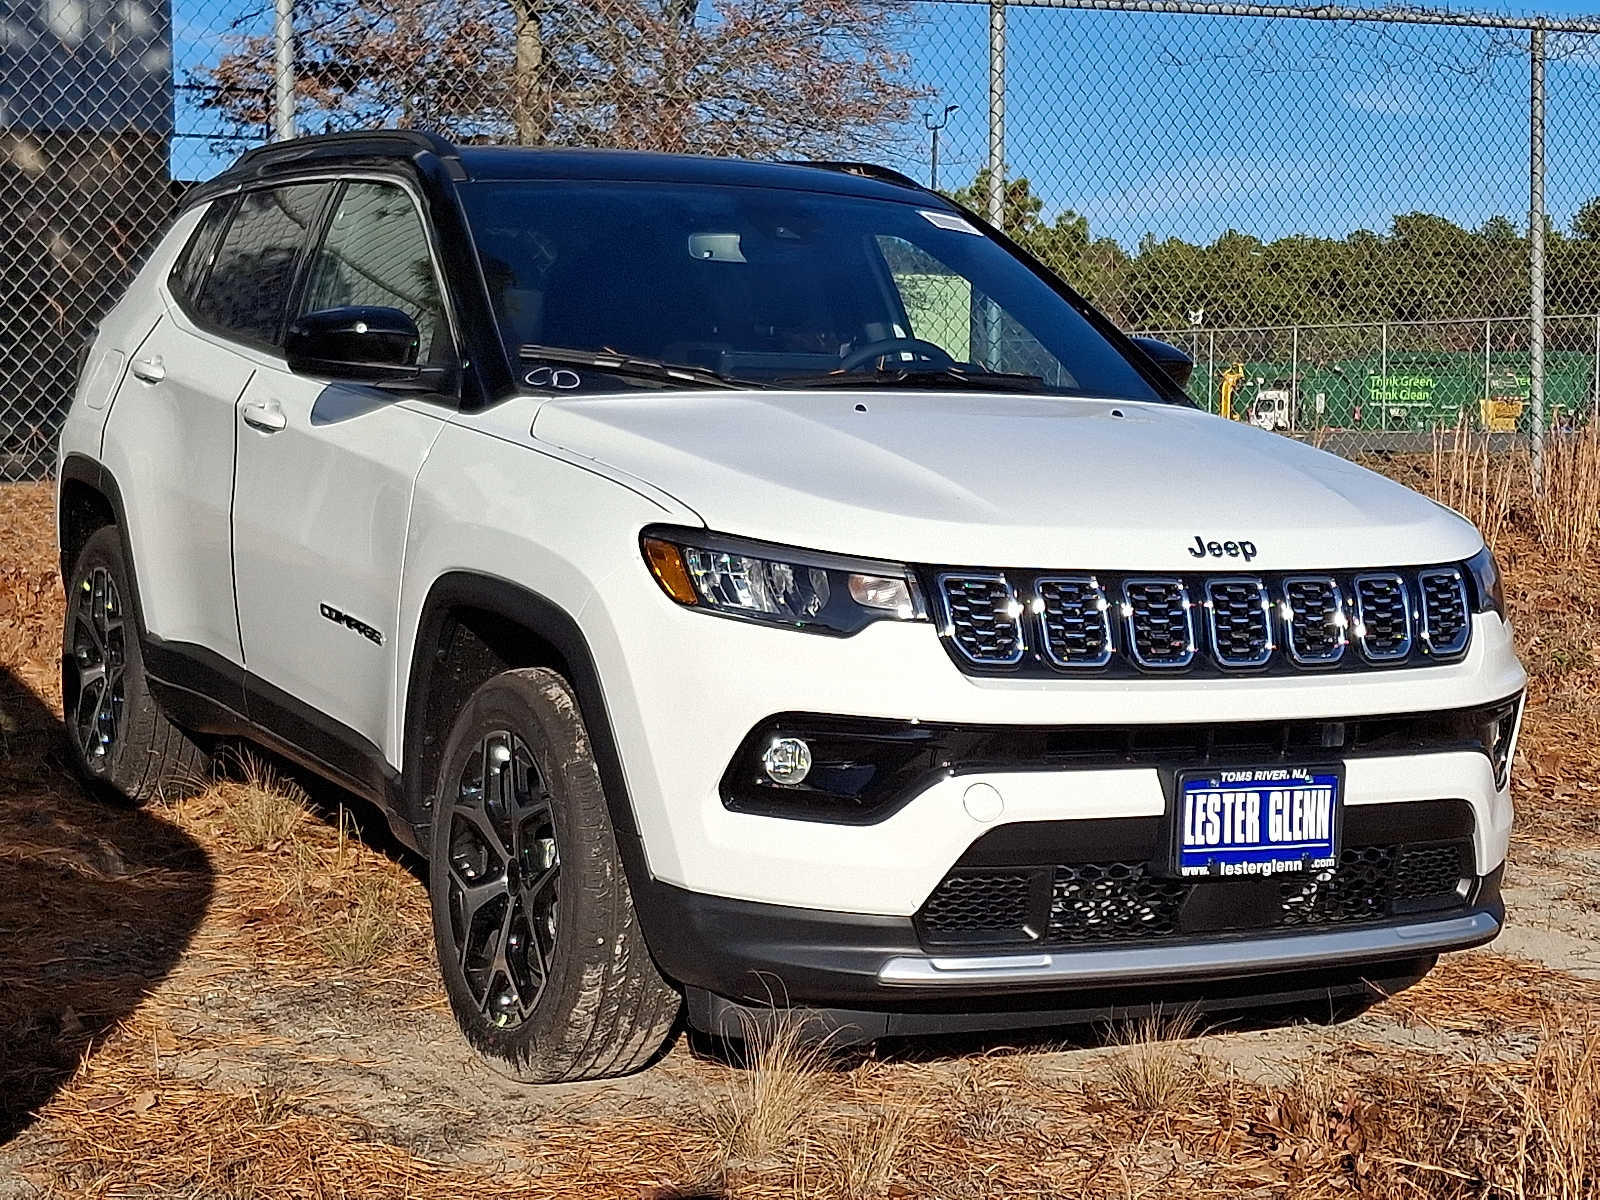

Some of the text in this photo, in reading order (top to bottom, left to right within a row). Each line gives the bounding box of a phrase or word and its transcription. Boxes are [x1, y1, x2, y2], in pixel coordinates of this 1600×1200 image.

[1188, 536, 1257, 562] Jeep
[1221, 771, 1252, 782] TOMS
[1254, 769, 1290, 781] RIVER,
[1184, 790, 1331, 845] LESTER GLENN
[1181, 858, 1334, 876] www. lesterglenn .com
